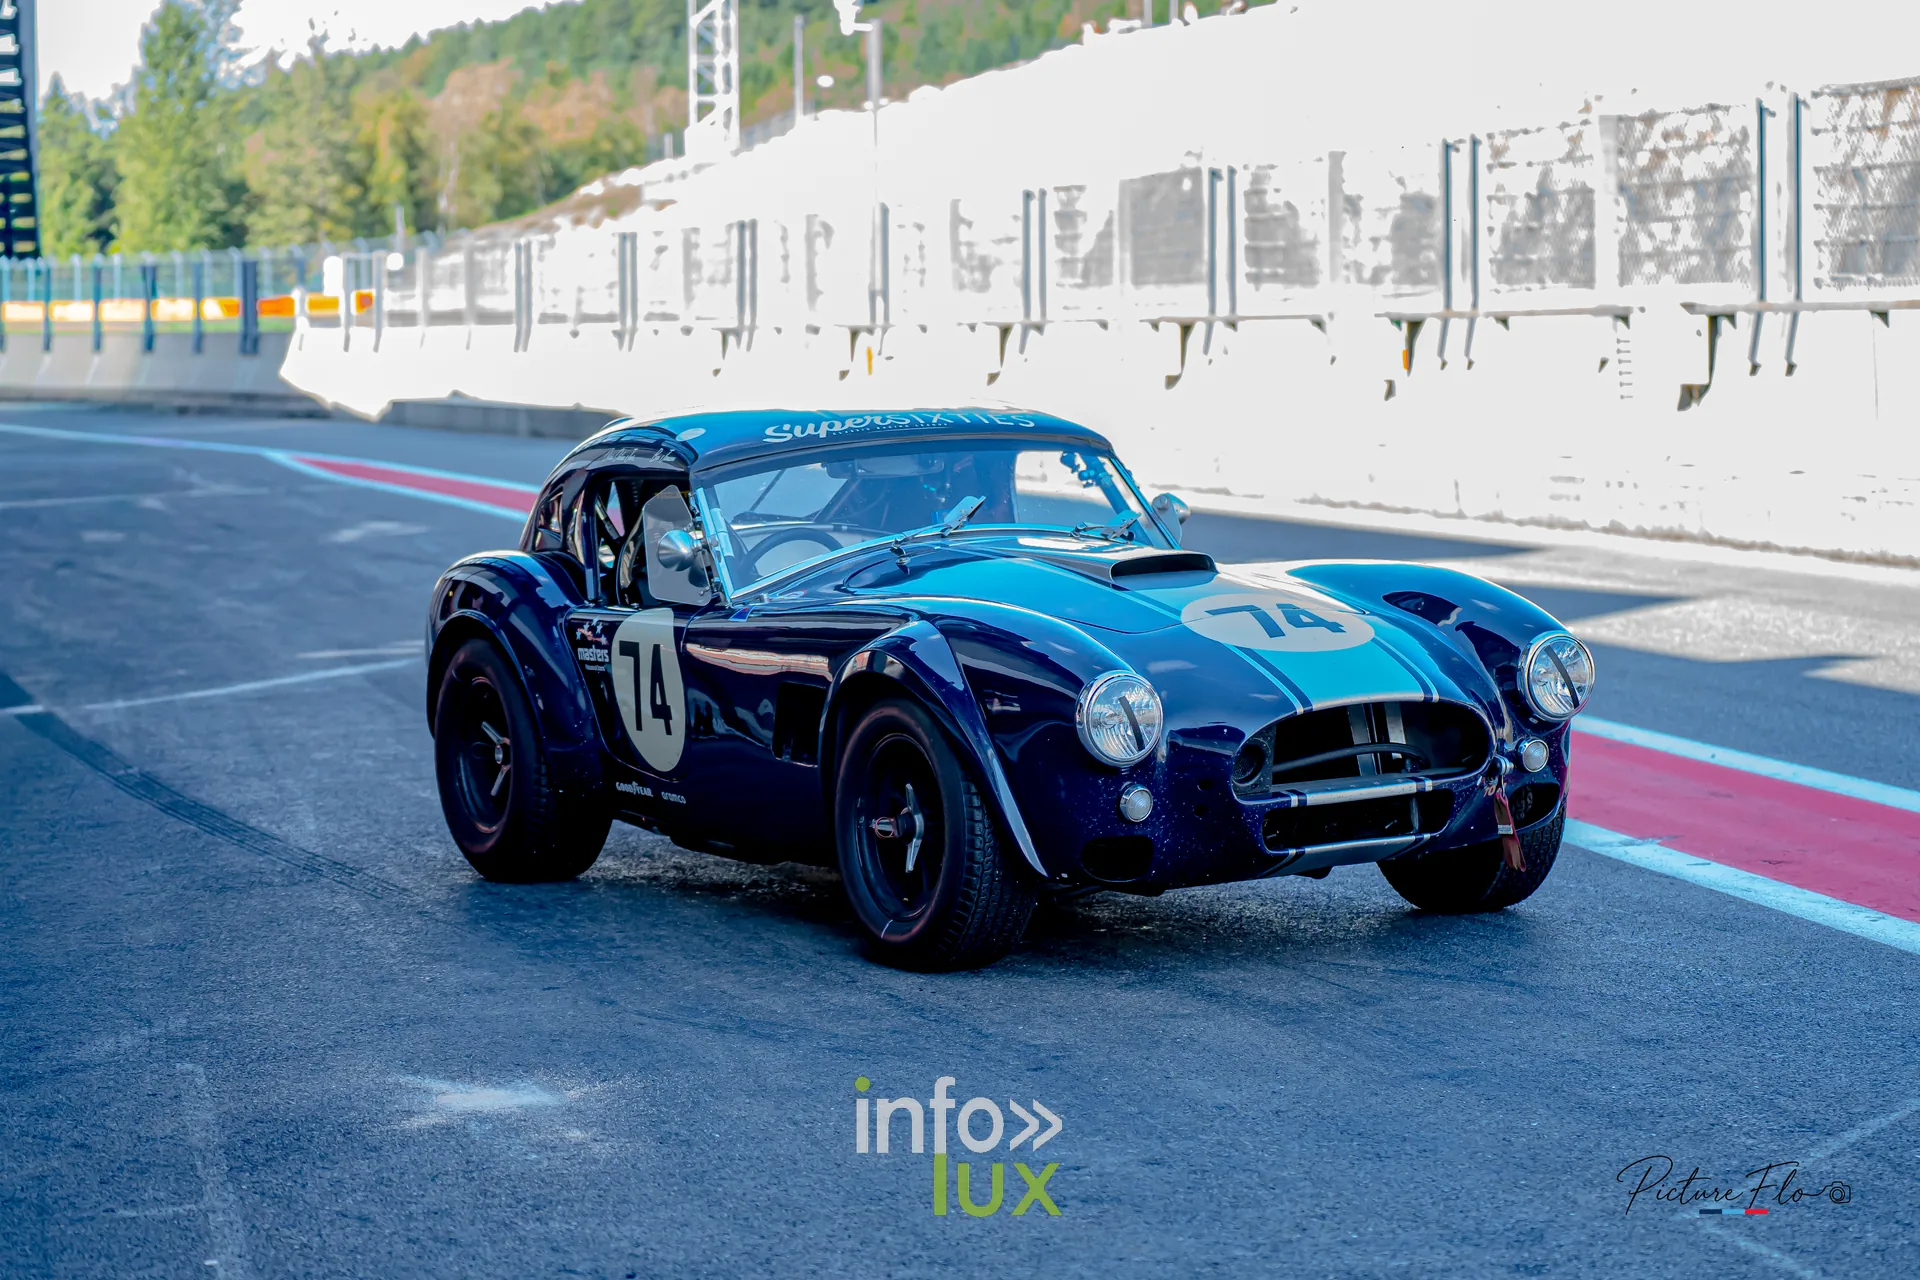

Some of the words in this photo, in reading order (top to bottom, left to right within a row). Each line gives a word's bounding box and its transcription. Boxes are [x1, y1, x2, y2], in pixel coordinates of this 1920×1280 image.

[1204, 603, 1347, 638] 74
[577, 644, 609, 662] masters
[619, 640, 672, 735] 74
